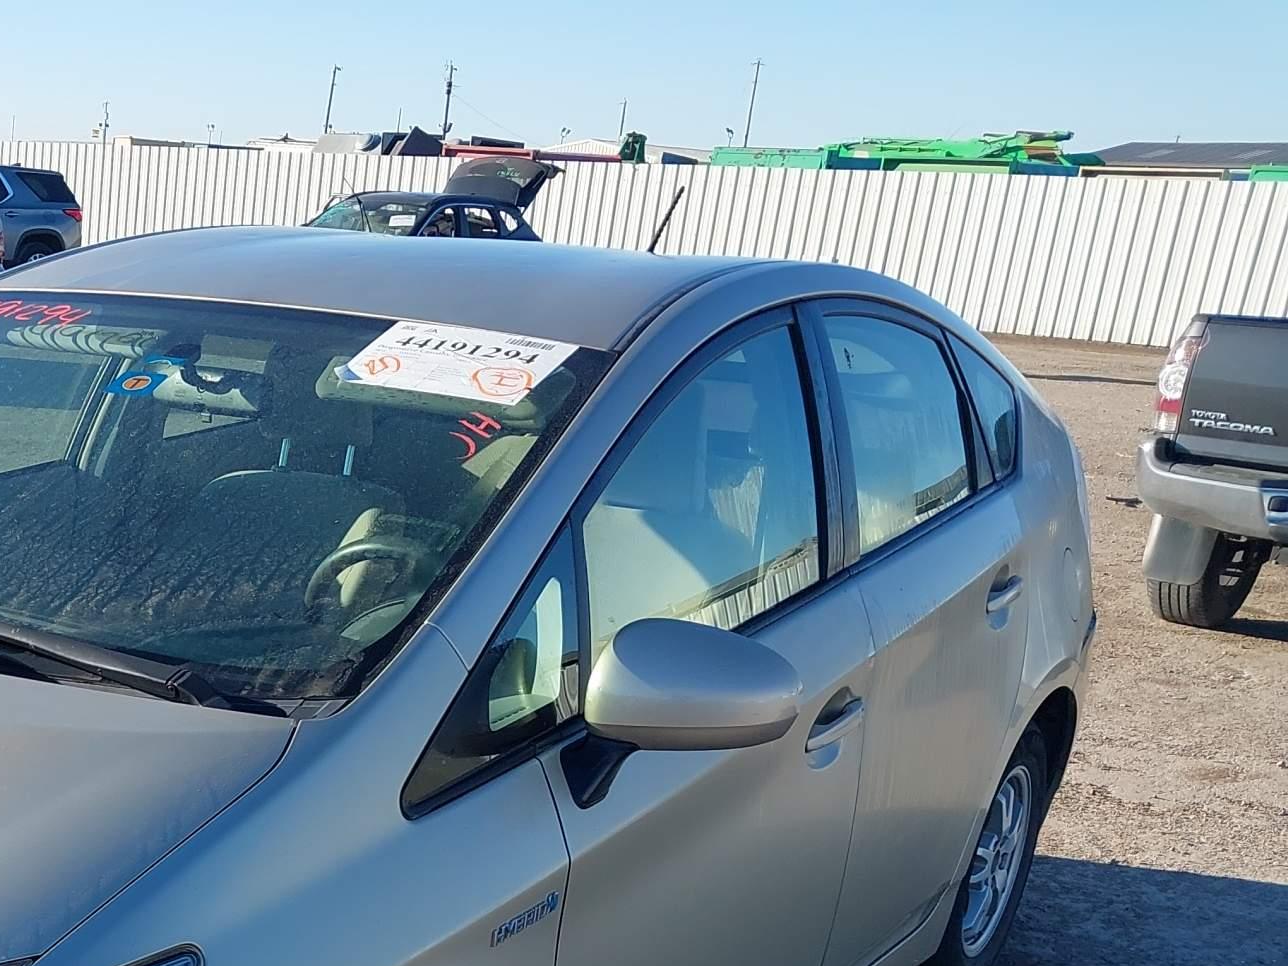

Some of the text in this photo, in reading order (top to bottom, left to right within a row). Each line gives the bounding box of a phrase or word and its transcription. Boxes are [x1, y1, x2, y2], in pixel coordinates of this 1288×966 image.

[395, 336, 540, 364] 44191294
[1191, 409, 1228, 421] TOYOTA
[1189, 418, 1275, 436] TACOMA
